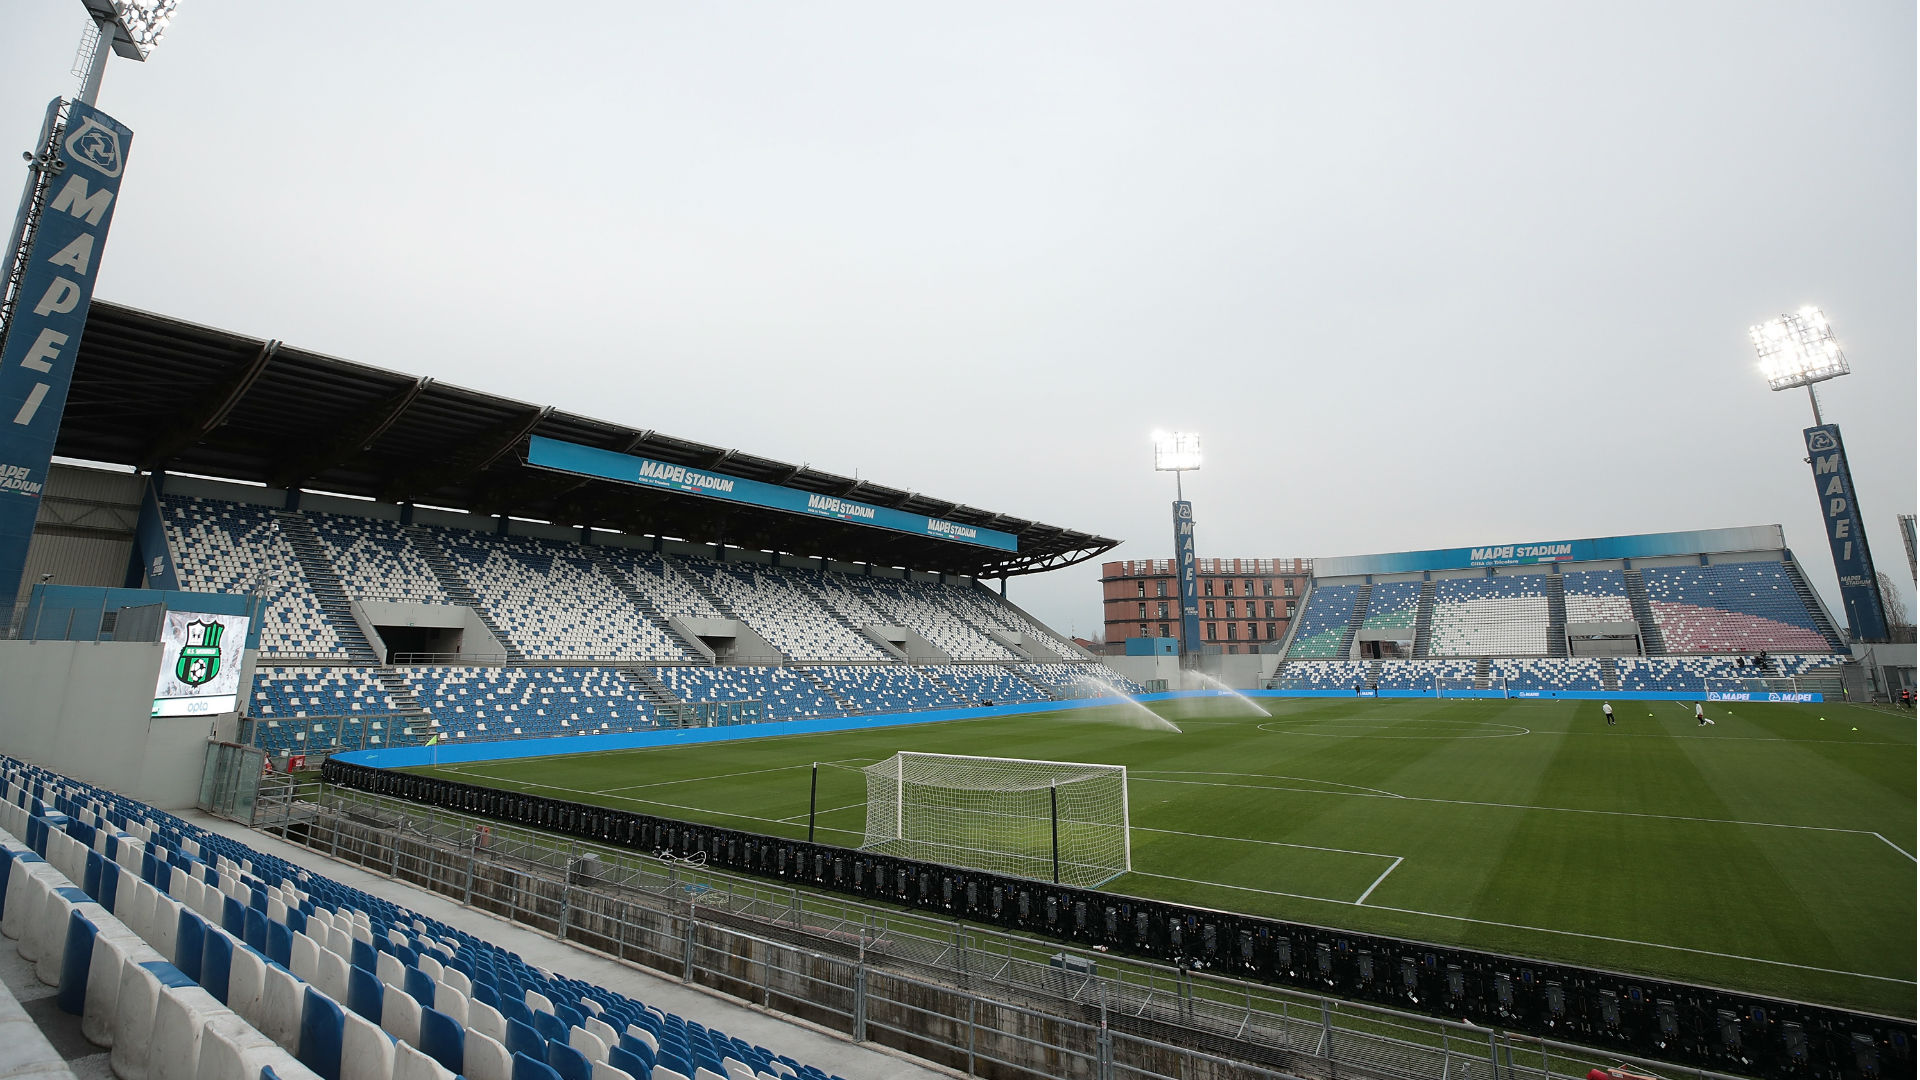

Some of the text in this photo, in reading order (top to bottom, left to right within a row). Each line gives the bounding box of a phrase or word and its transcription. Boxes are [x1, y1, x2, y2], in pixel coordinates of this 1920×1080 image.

[13, 173, 114, 426] MAPEI
[0, 464, 31, 480] APEI
[640, 460, 687, 483] MAPEI
[685, 472, 734, 493] STADIUM
[0, 476, 43, 493] TADIUM
[808, 494, 840, 512] MAPEI
[840, 503, 875, 519] STADIUM
[1815, 453, 1852, 561] MAPEI
[928, 518, 951, 533] MAPEI
[950, 525, 976, 538] STADIUM
[1180, 521, 1194, 597] MAPEI
[1470, 544, 1572, 561] MAPEI STADIUM
[1722, 693, 1750, 701] MAPEI
[1782, 693, 1812, 702] MAPEI
[187, 701, 209, 713] opta
